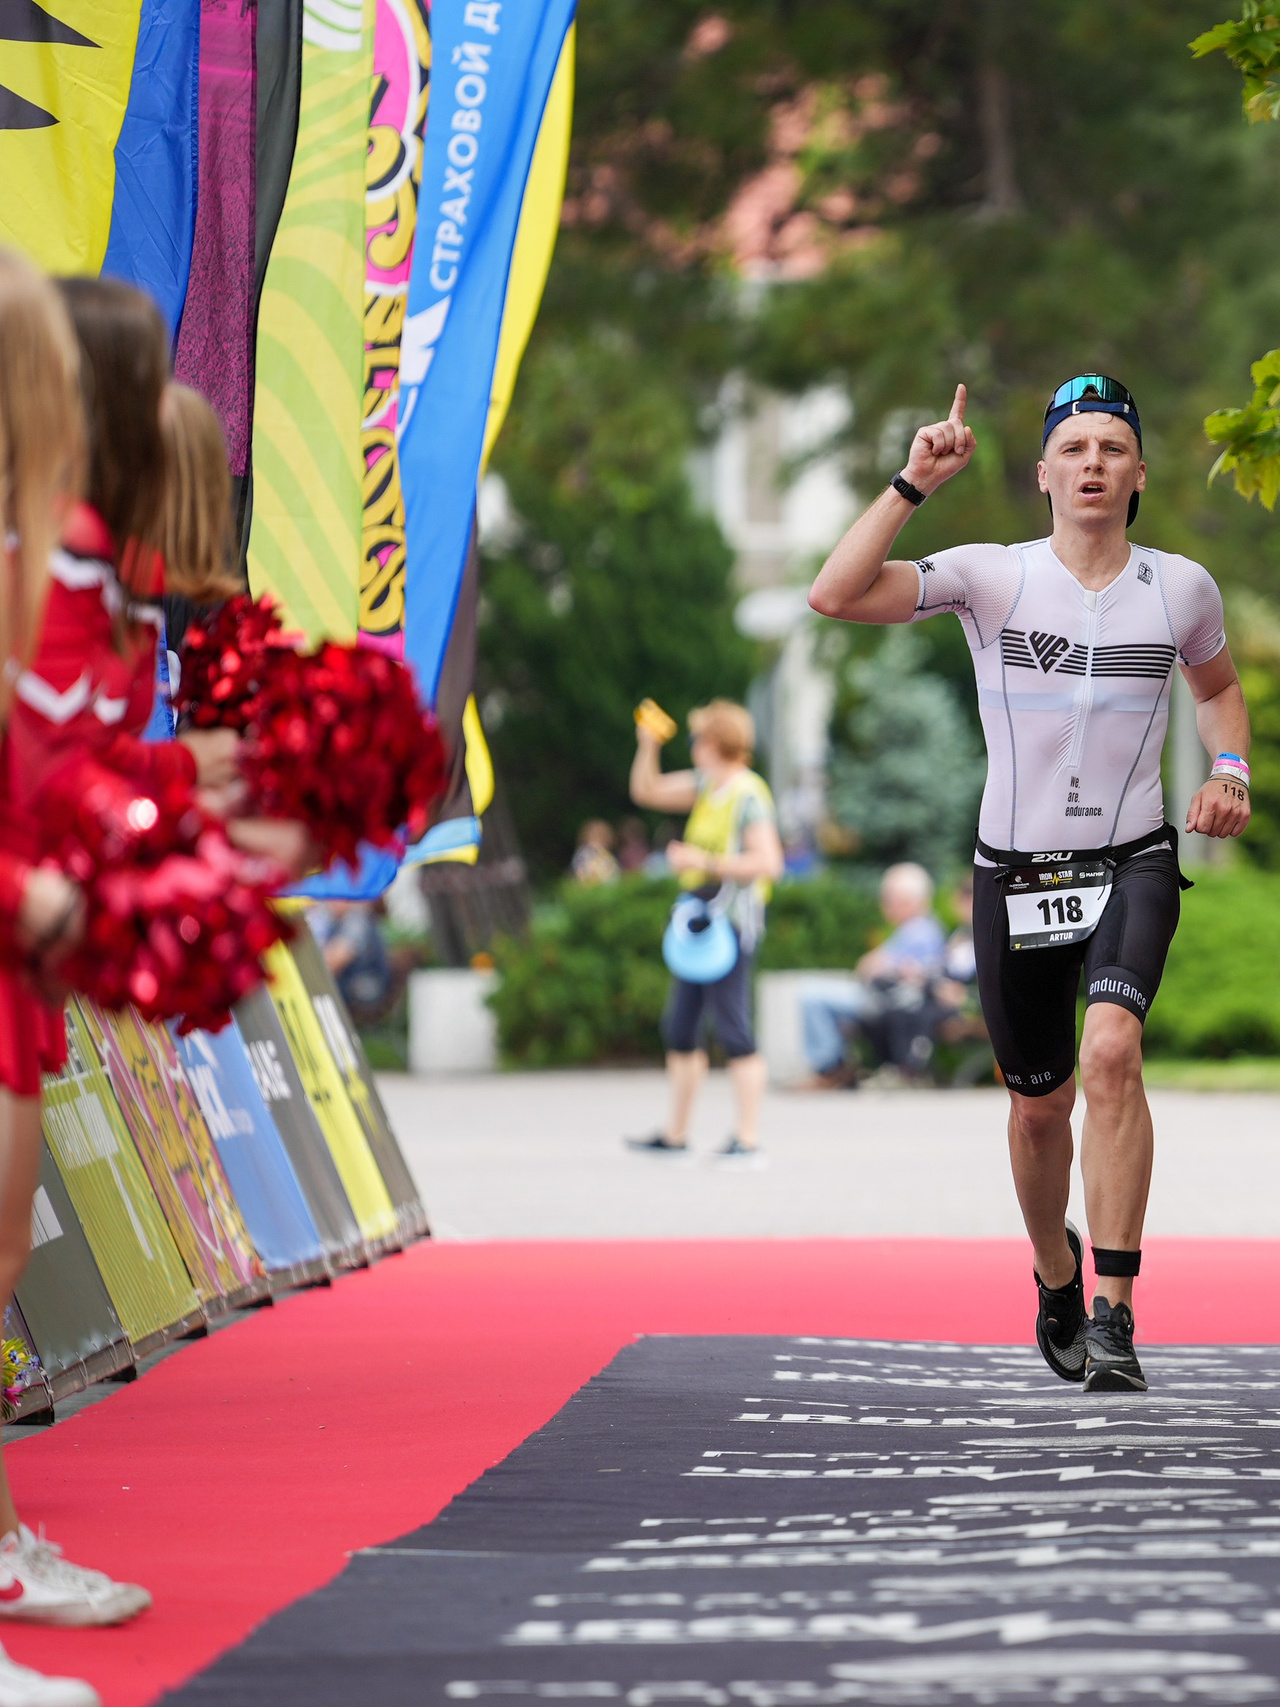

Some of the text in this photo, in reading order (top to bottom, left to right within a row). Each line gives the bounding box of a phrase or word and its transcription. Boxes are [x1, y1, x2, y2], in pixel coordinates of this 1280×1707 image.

[429, 41, 492, 293] СТРАХОВОЙ
[1222, 784, 1245, 801] 118
[1065, 806, 1104, 817] endurance.
[1031, 852, 1073, 863] 2XU
[1057, 870, 1073, 879] STAR
[1037, 896, 1083, 926] 118
[1049, 932, 1073, 942] ARTUR
